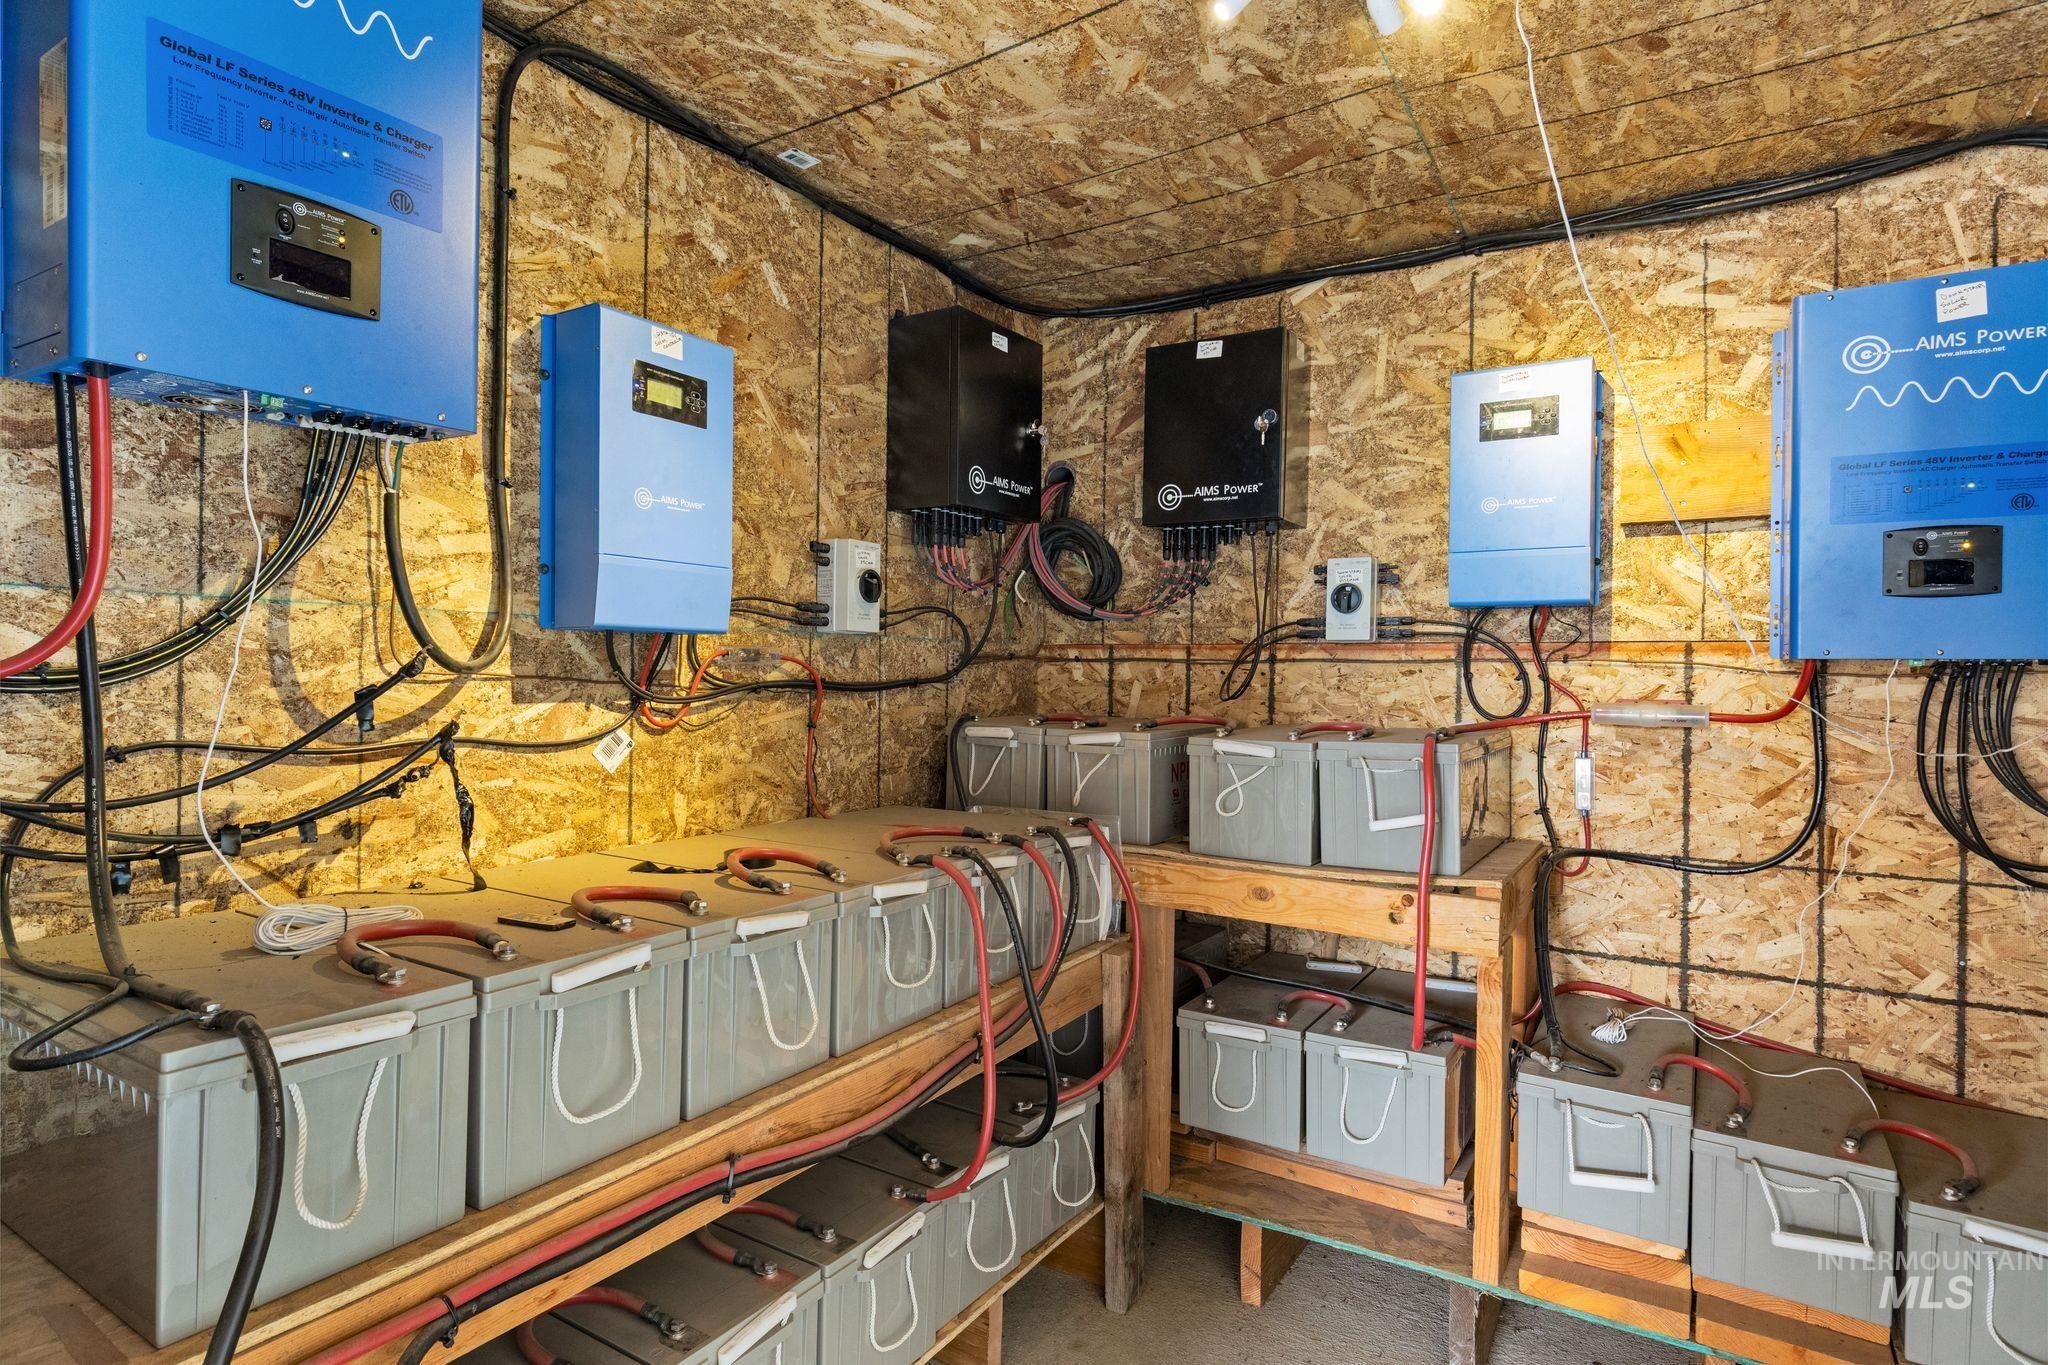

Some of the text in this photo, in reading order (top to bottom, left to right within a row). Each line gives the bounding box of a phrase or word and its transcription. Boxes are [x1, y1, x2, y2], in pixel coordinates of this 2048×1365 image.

[160, 35, 433, 152] Global LF Series 48V Inverter & Charger
[172, 55, 193, 69] Low
[195, 64, 243, 89] Frequency
[244, 83, 277, 101] Inverter
[297, 104, 328, 121] Charger
[372, 133, 401, 150] Transfer
[402, 145, 425, 159] Switch
[1915, 325, 2048, 351] AIMS POWER
[1935, 345, 2006, 358] www.aimscorp.net
[1839, 450, 2048, 471] Global LF Series 48V Inverter & Charge
[992, 476, 1031, 495] AIMS POWER
[1194, 484, 1259, 497] AIMS POWER
[660, 495, 679, 506] AIMS
